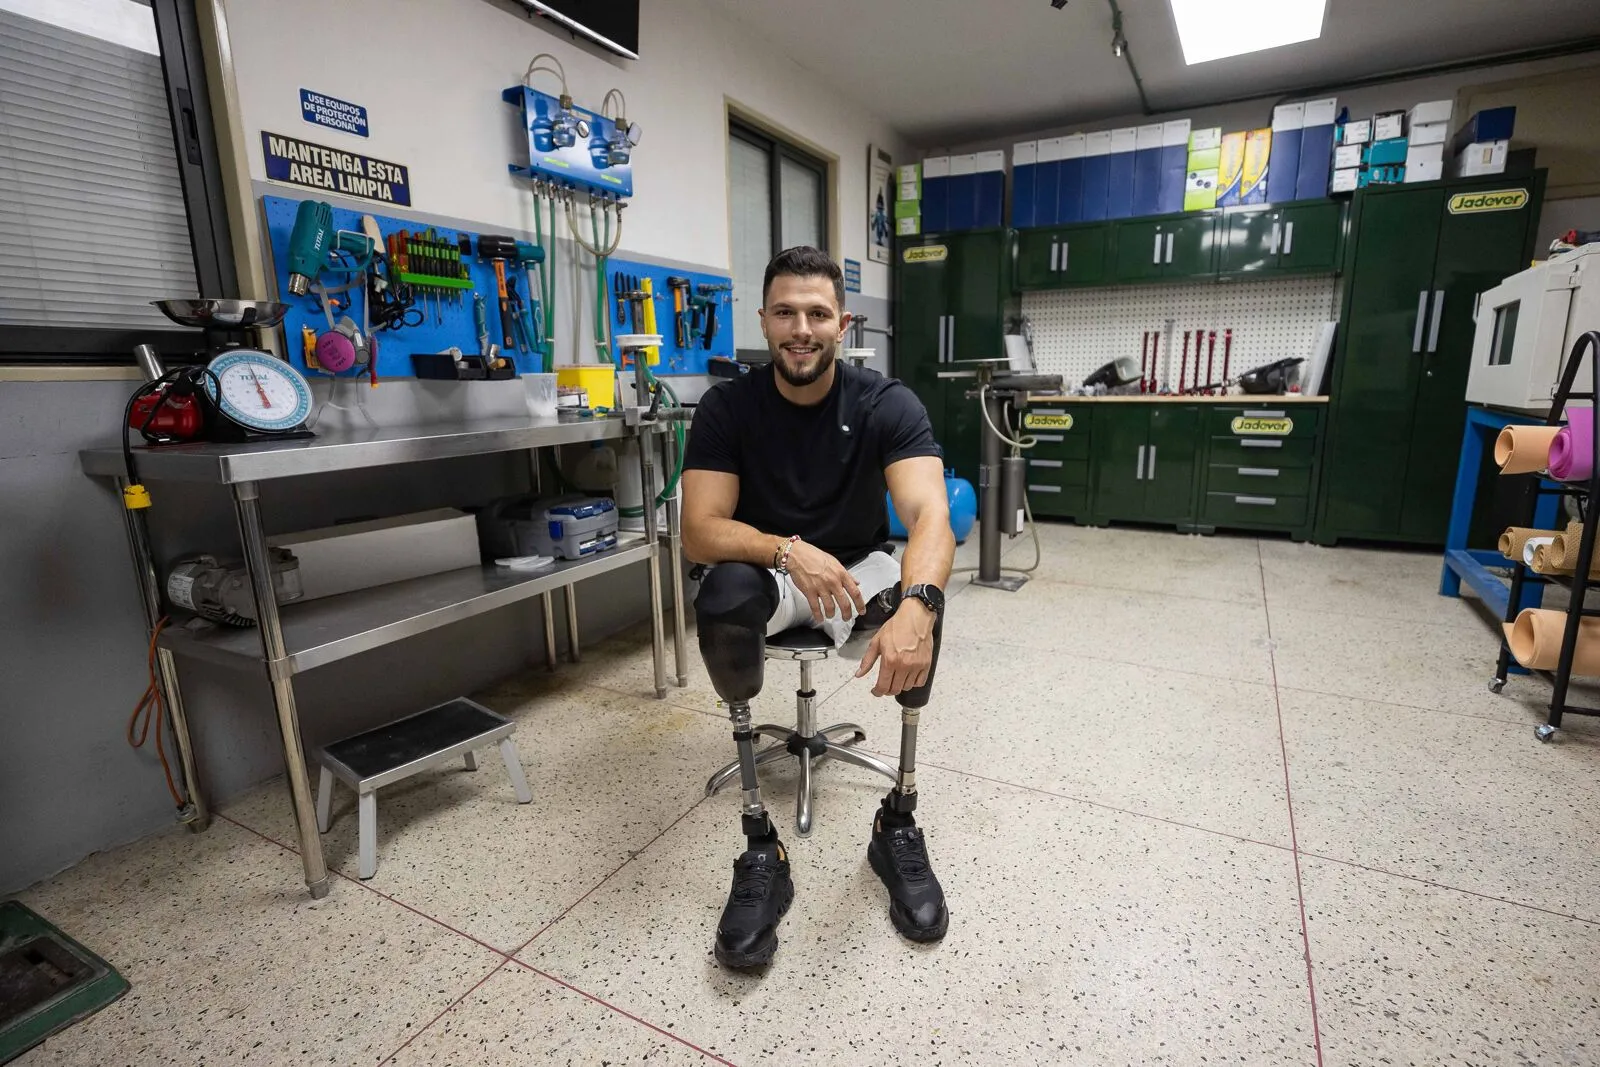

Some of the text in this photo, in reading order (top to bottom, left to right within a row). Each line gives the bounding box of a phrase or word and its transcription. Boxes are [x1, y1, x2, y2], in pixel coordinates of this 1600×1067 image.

[303, 101, 366, 127] DE PROTECCIÓN
[308, 93, 360, 116] USE EQUIPOS
[315, 113, 358, 132] PERSONAL
[269, 136, 404, 185] MANTENGA ESTA
[289, 162, 393, 201] AREA LIMPIA
[1454, 192, 1525, 211] Jadever
[314, 228, 325, 251] TOTAL
